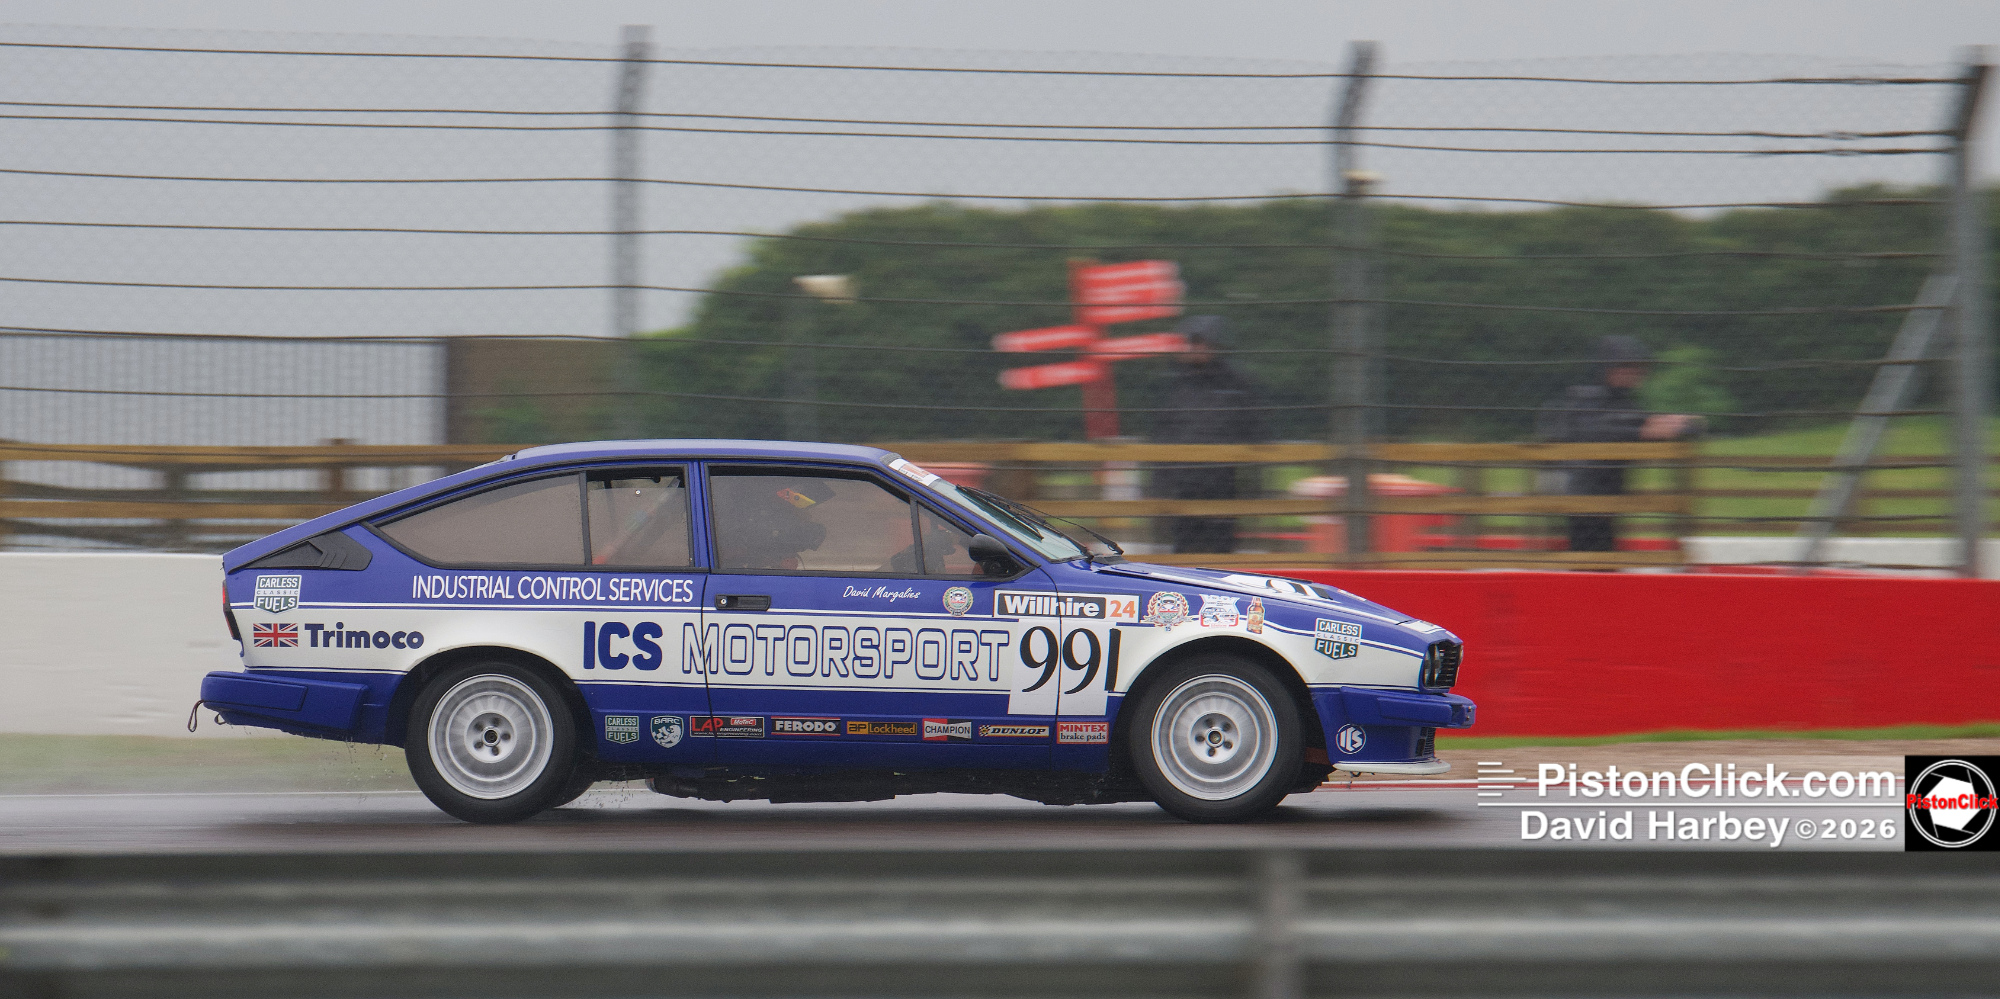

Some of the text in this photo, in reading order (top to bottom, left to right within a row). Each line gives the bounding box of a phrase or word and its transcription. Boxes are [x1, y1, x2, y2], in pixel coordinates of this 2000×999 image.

[259, 577, 298, 588] CARLESS
[412, 575, 693, 603] INDUSTRIAL CONTROL SERVICES
[843, 585, 872, 598] David
[257, 597, 296, 612] FUELS
[1003, 594, 1136, 618] Willhire 24
[1319, 621, 1359, 636] CARLESS
[304, 621, 425, 650] Trimoco
[1316, 632, 1360, 643] CLASSIC
[583, 621, 1010, 682] ICS MOTORSPORT
[1316, 639, 1357, 659] FUELS
[1020, 625, 1122, 695] 991
[607, 717, 637, 726] CARLESS
[654, 717, 681, 725] BARC
[691, 717, 724, 732] LAP
[775, 720, 837, 732] FERODO
[869, 723, 916, 735] Lockheed
[925, 725, 971, 735] CHAMPION
[991, 726, 1046, 735] DUNLOP
[1059, 724, 1106, 733] MINTEX
[608, 732, 637, 742] FUELS
[1060, 733, 1106, 743] brake pads
